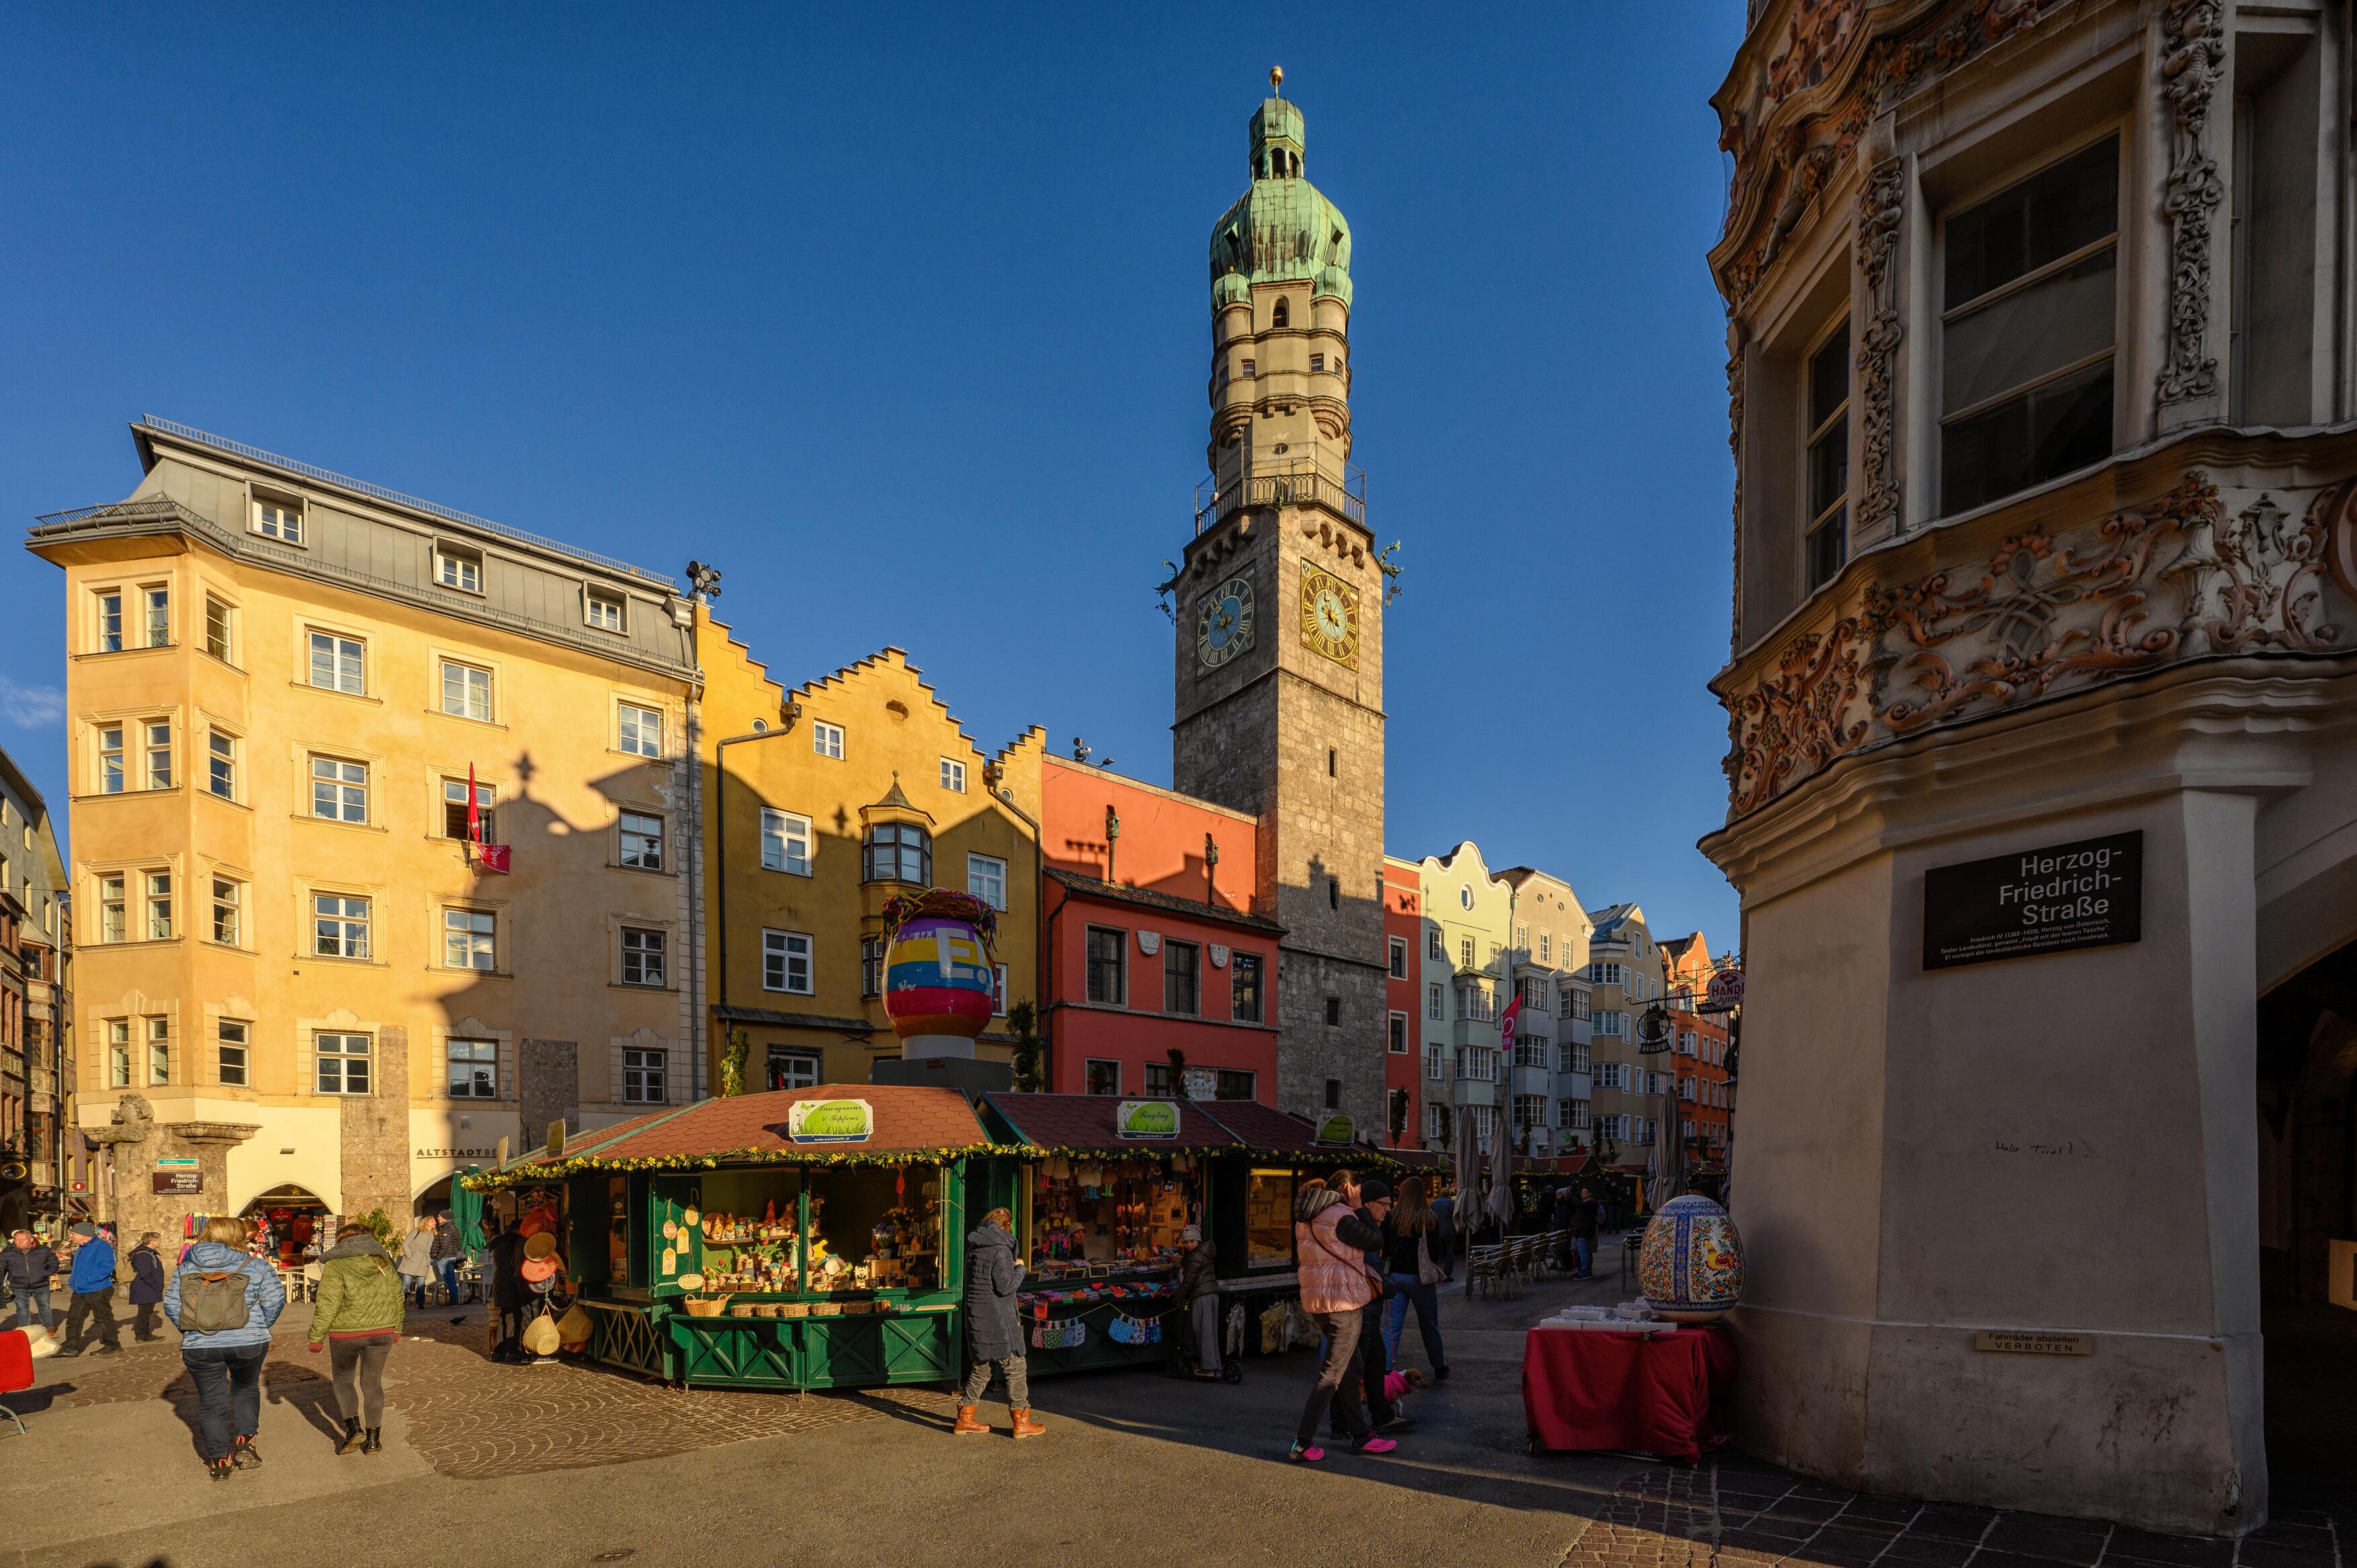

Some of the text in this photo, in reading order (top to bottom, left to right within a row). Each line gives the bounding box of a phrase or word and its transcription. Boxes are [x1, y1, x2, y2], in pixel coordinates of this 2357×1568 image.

[2021, 848, 2122, 877] Herzog-
[2000, 869, 2122, 906] Friedrich-
[2022, 896, 2109, 925] Straße
[1970, 934, 1994, 943] Friedrich
[2041, 924, 2063, 934] Herzog
[1953, 951, 1975, 960] verlegte
[2033, 939, 2060, 947] Residenz
[1994, 939, 2018, 947] genannt
[1642, 1043, 1667, 1052] Happ
[817, 1104, 861, 1113] Lasergravur
[1989, 1333, 2079, 1344] Fahrräder abstellen
[1995, 1342, 2073, 1352] VERBOTEN
